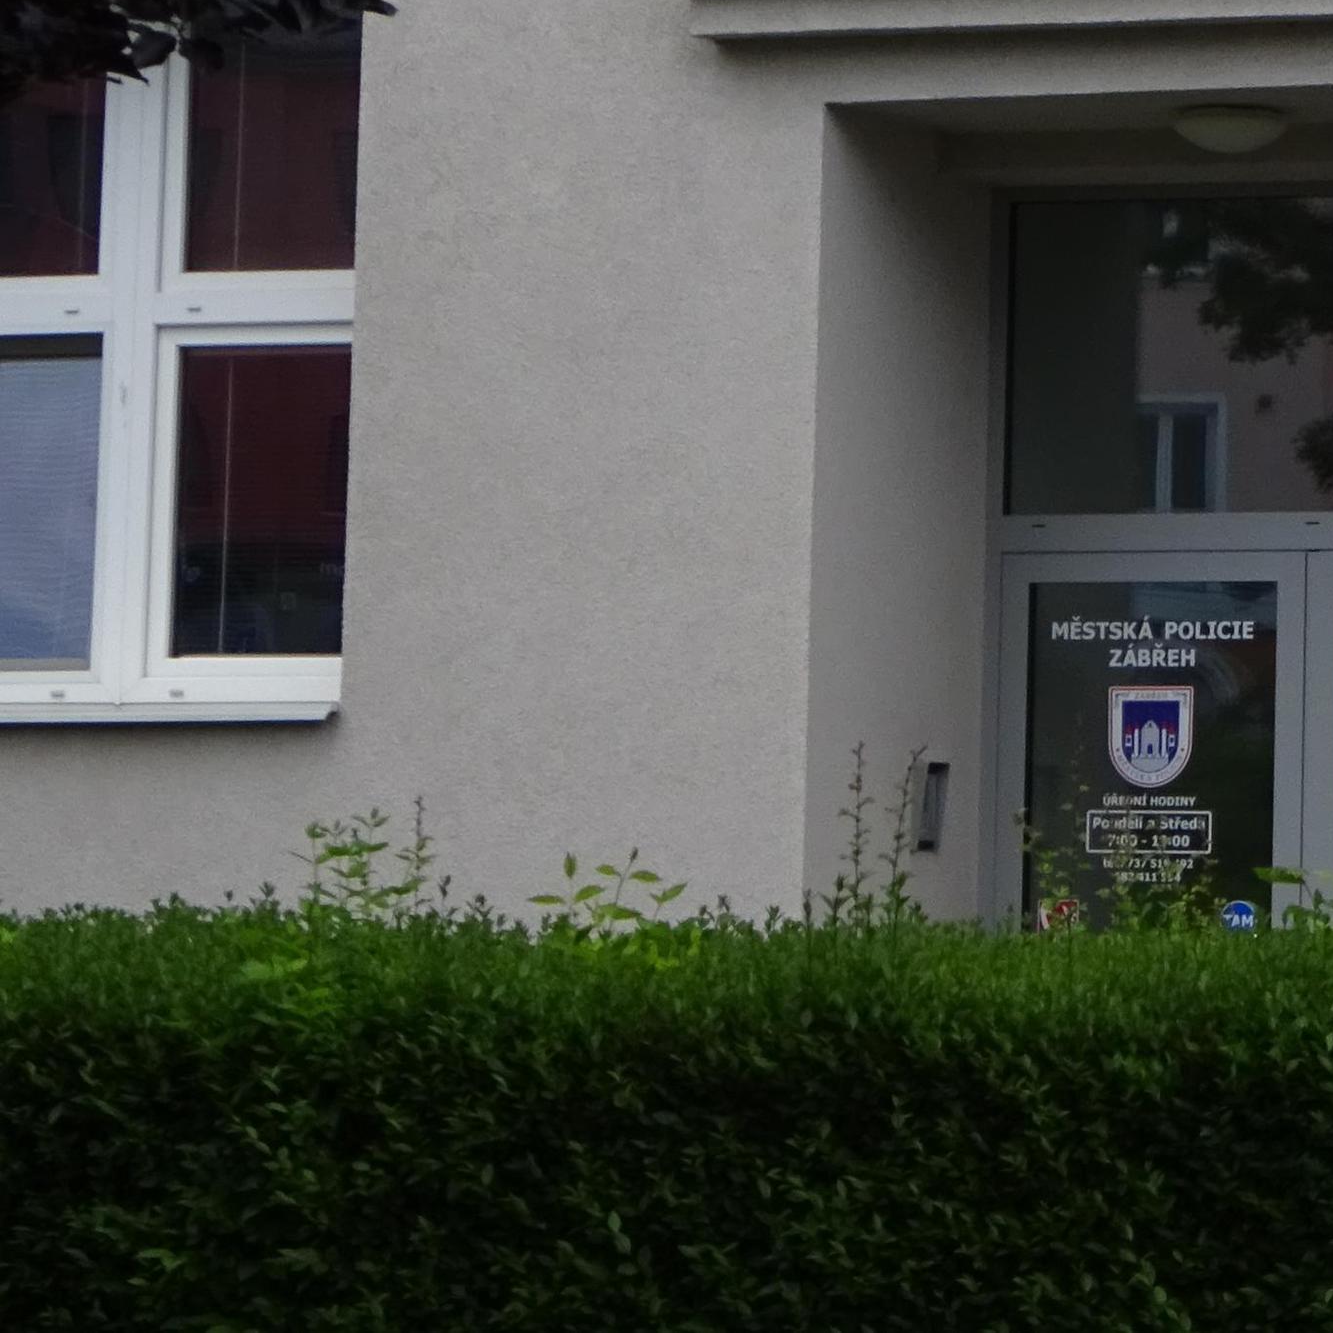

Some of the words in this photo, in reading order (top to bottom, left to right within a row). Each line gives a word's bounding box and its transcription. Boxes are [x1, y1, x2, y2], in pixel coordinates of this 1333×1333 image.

[1051, 616, 1152, 641] MĚSTSKÁ
[1164, 620, 1254, 641] POLICIE
[1109, 644, 1196, 667] ZÁBŘEH
[1150, 795, 1196, 806] HODINY
[1152, 835, 1190, 847] 1:00
